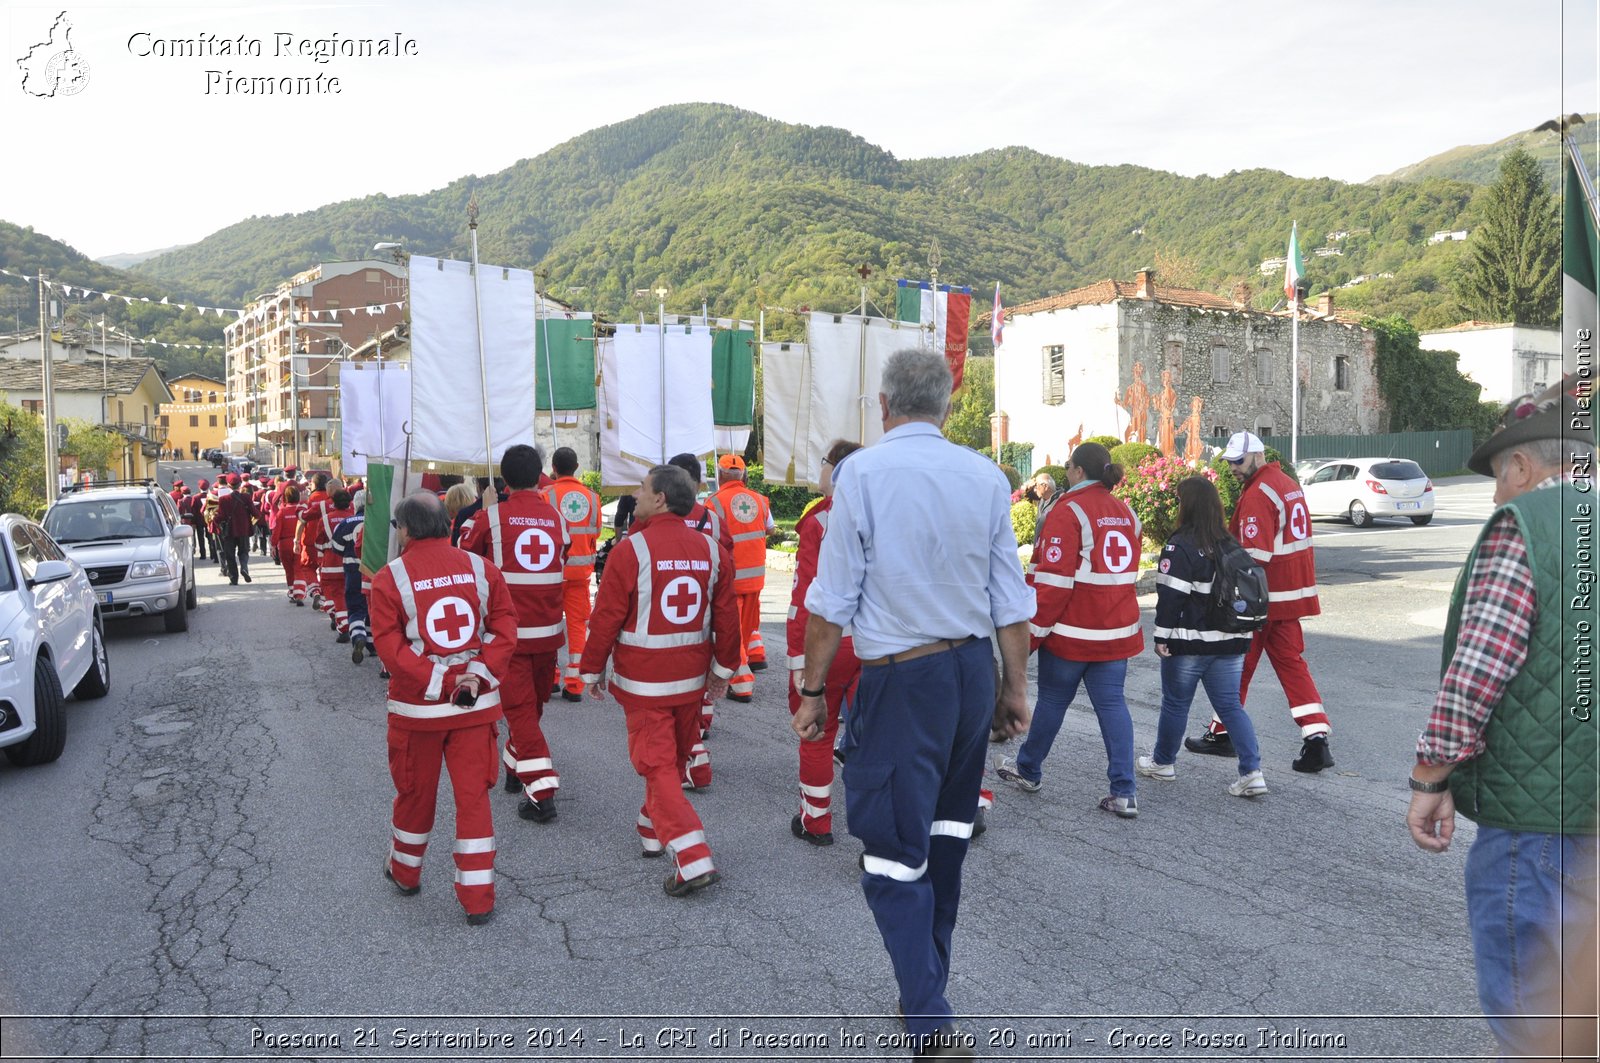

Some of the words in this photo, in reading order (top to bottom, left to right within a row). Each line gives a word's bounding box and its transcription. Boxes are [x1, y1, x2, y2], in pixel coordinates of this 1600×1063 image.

[508, 516, 525, 526] CROCE
[525, 517, 538, 526] ROSSA
[656, 560, 674, 571] CROCE
[674, 560, 690, 571] ROSSA
[690, 560, 709, 571] ITALIANA
[414, 579, 433, 591] CROCE
[433, 576, 453, 588] ROSSA
[452, 573, 475, 584] ITALIANA
